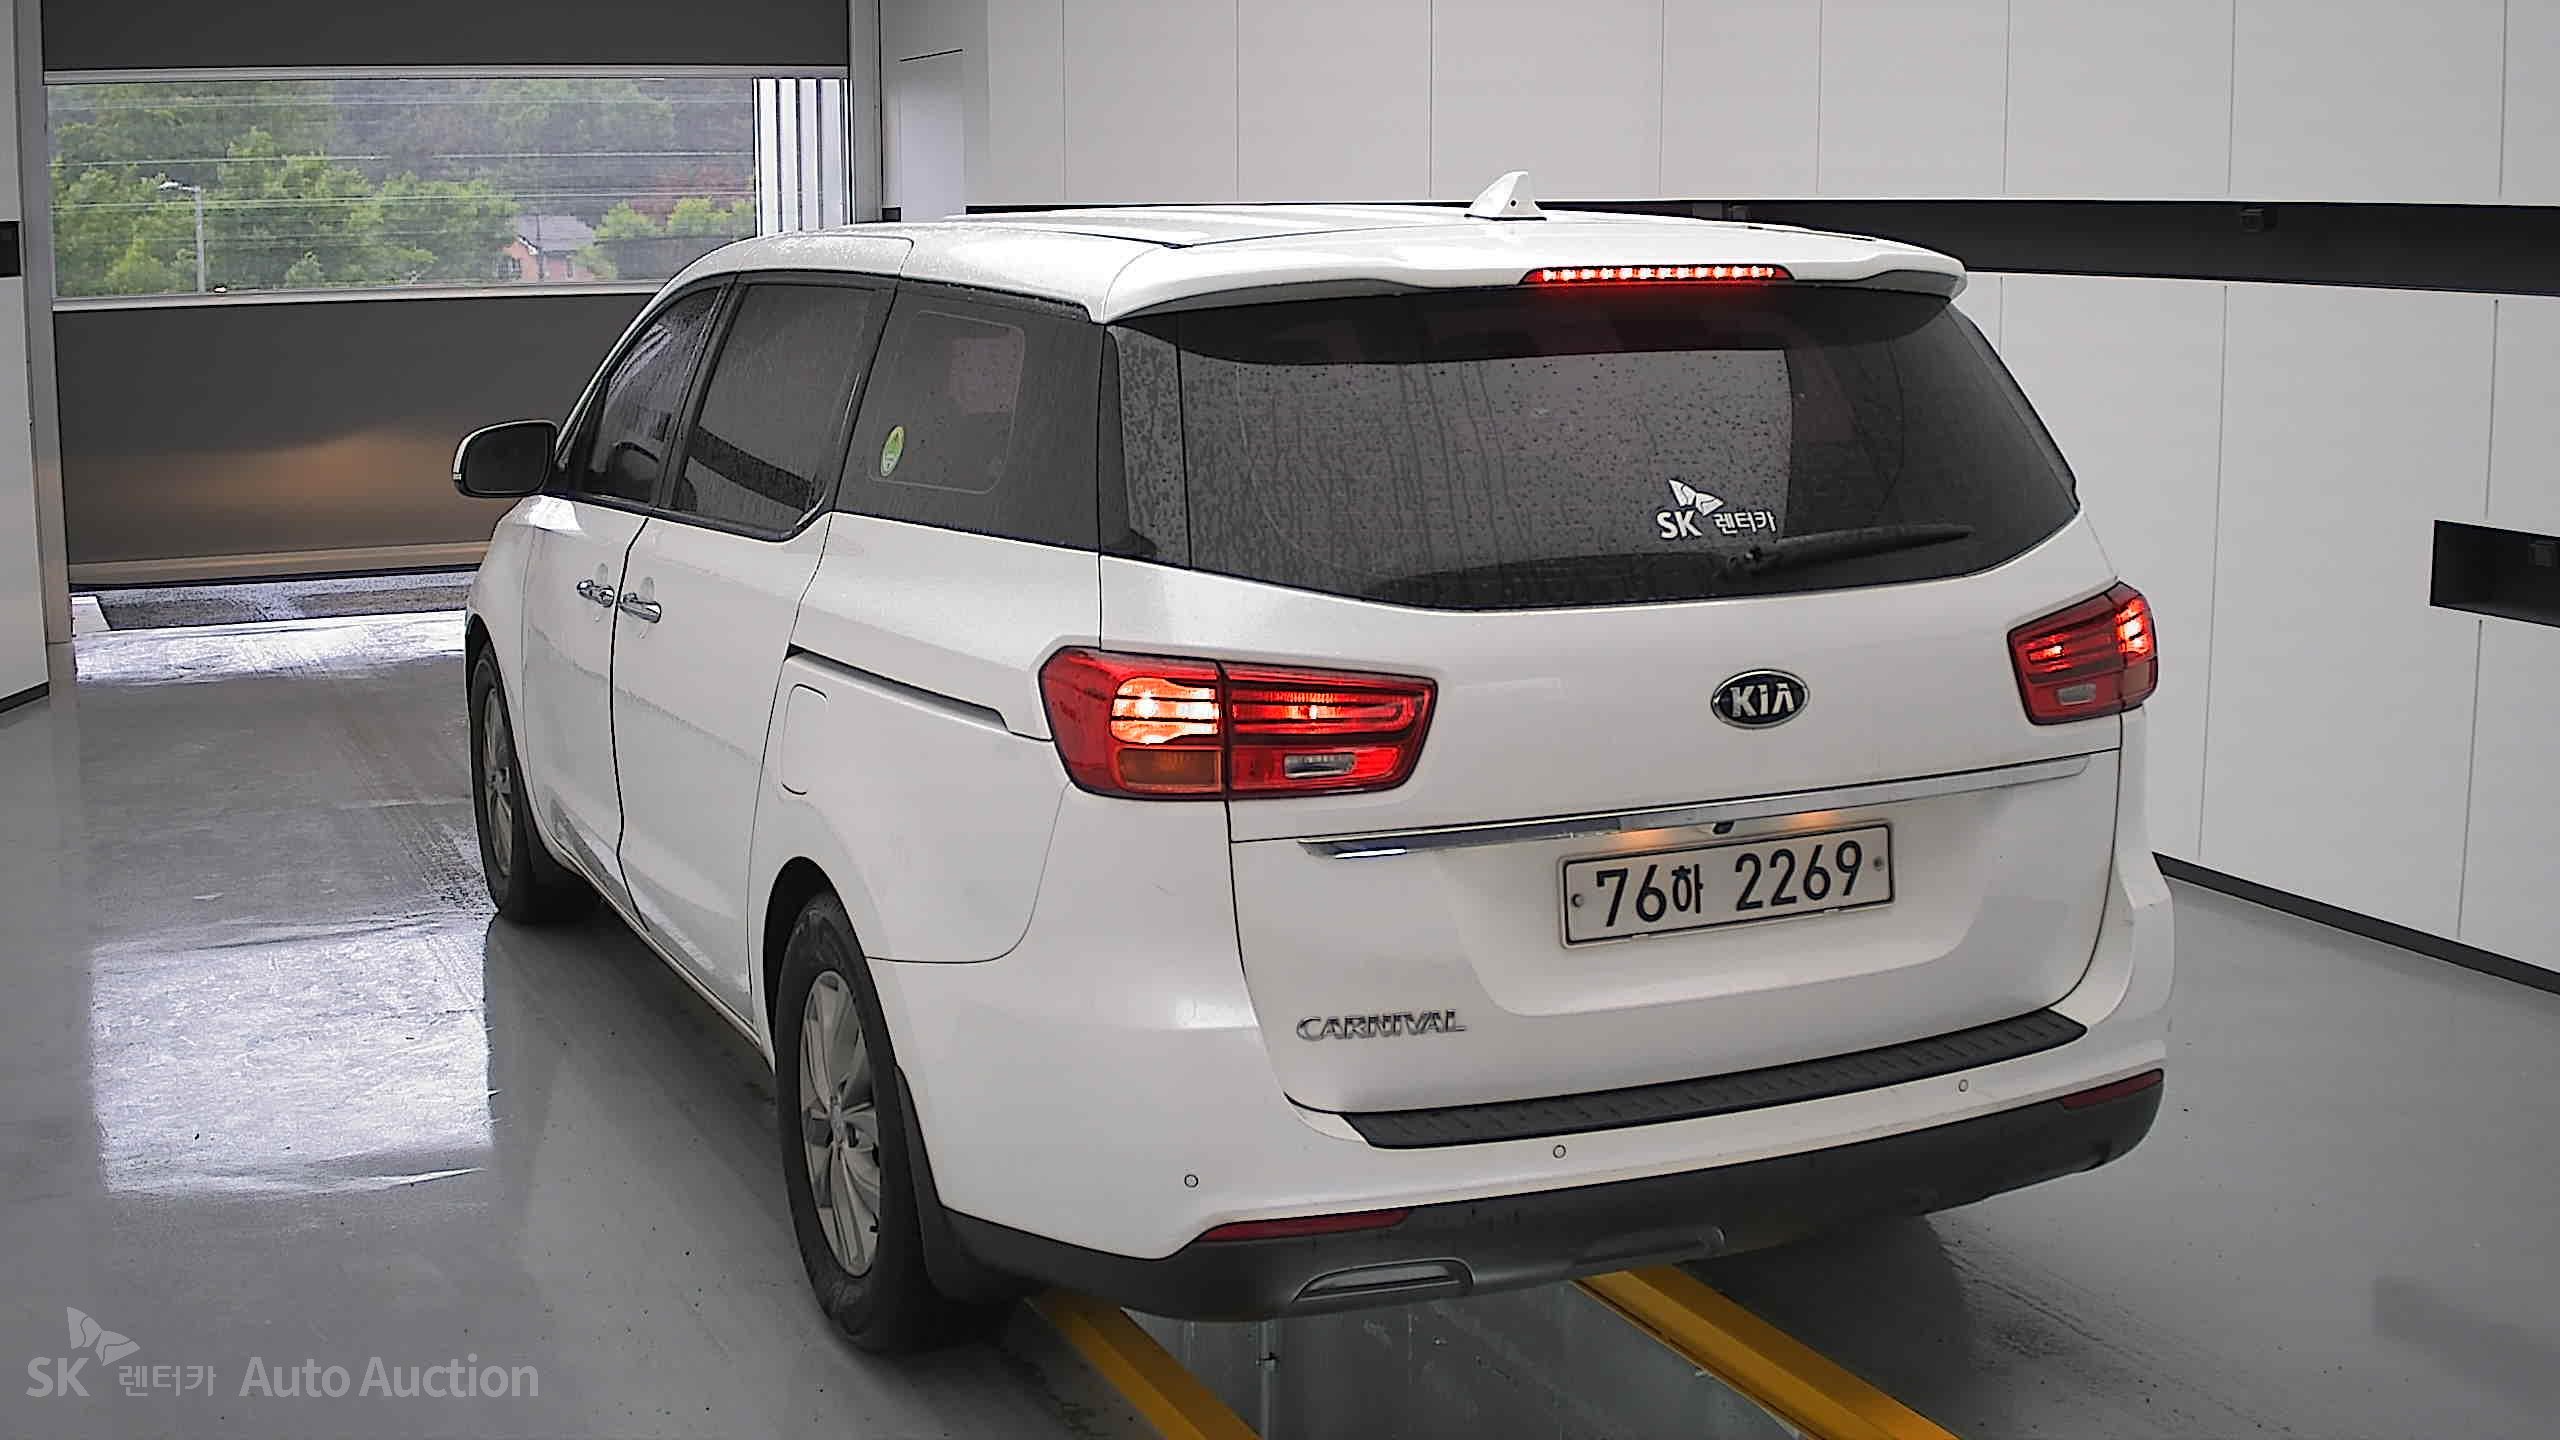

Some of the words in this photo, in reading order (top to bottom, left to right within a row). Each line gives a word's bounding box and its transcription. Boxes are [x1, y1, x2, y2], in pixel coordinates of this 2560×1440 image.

[1656, 510, 1703, 539] SK
[1713, 511, 1777, 535] 렌터카
[1729, 682, 1795, 718] KIA
[1595, 863, 1704, 928] 76하
[1734, 840, 1863, 912] 2269
[1296, 1009, 1467, 1041] CARNIVAL
